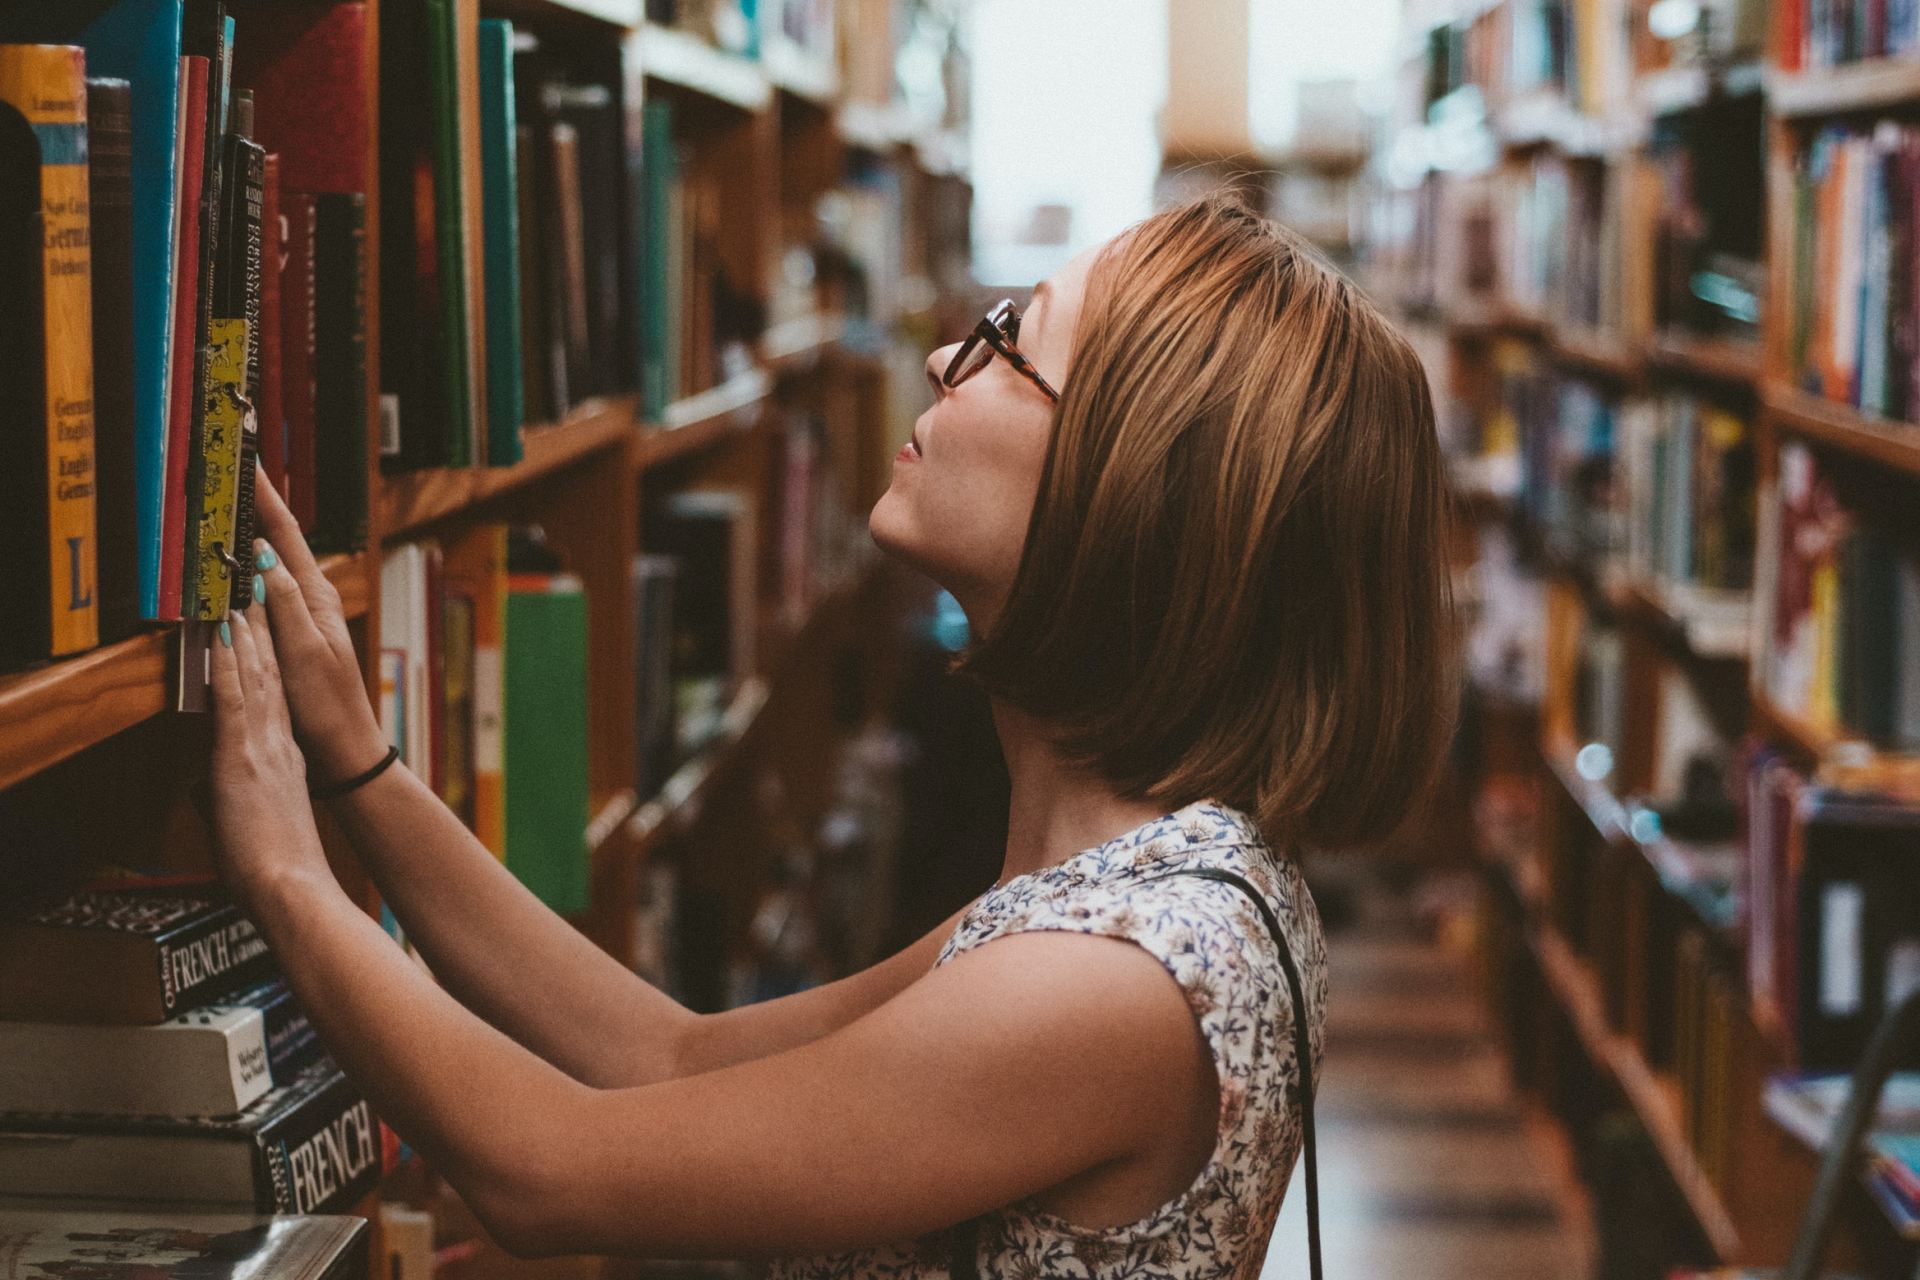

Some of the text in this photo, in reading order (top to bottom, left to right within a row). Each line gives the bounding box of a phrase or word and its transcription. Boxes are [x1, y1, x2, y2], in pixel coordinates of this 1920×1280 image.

[66, 537, 92, 611] L
[160, 944, 175, 1009] Oxford
[171, 928, 231, 993] FRENCH
[289, 1099, 375, 1216] FRENCH
